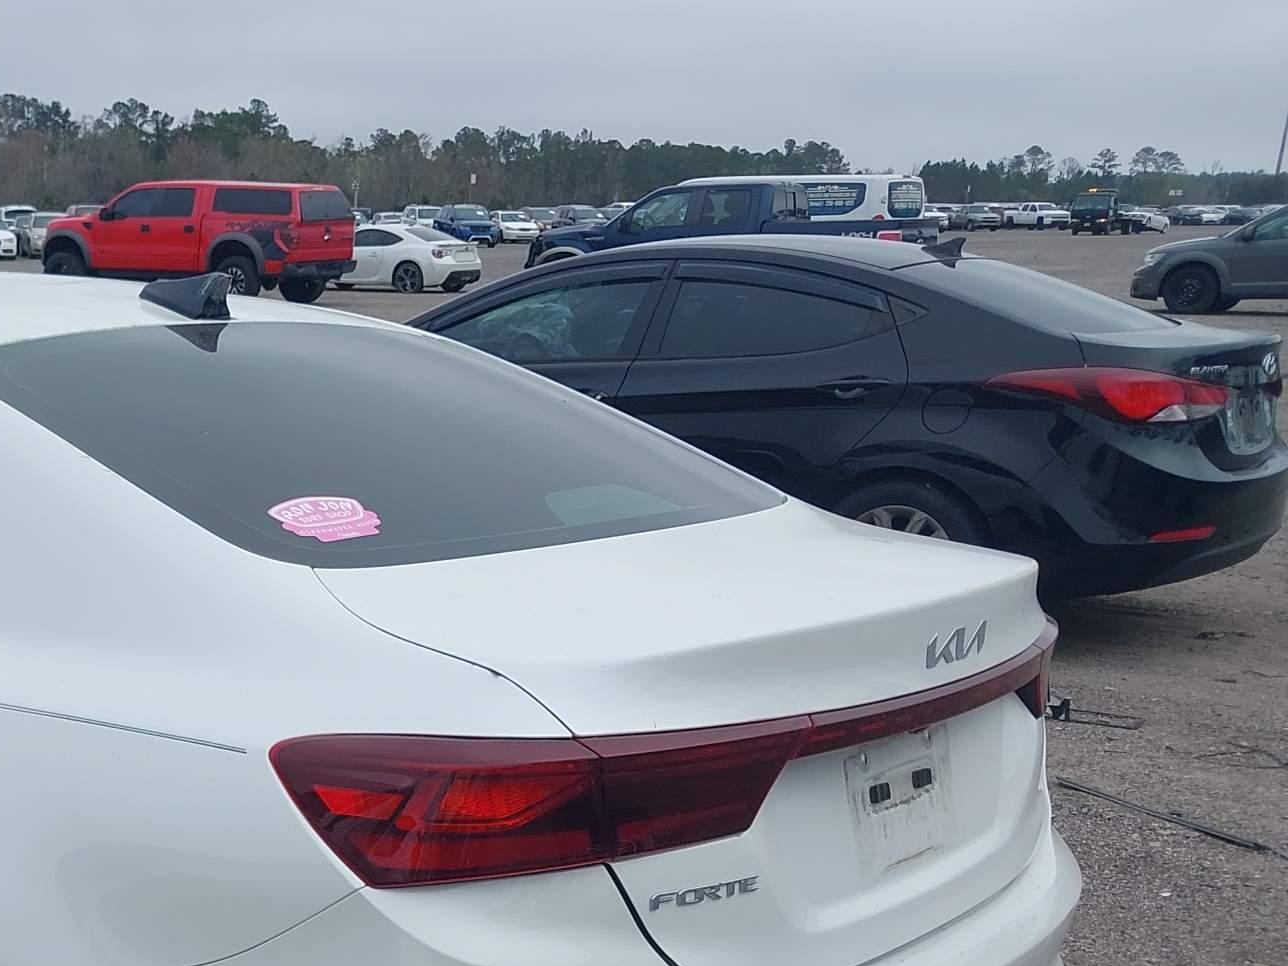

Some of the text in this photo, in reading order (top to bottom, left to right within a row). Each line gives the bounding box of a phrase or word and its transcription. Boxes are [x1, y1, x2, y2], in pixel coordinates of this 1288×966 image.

[1190, 364, 1229, 375] ELANTRA
[281, 501, 353, 520] RON JON
[649, 875, 760, 912] FORTE
